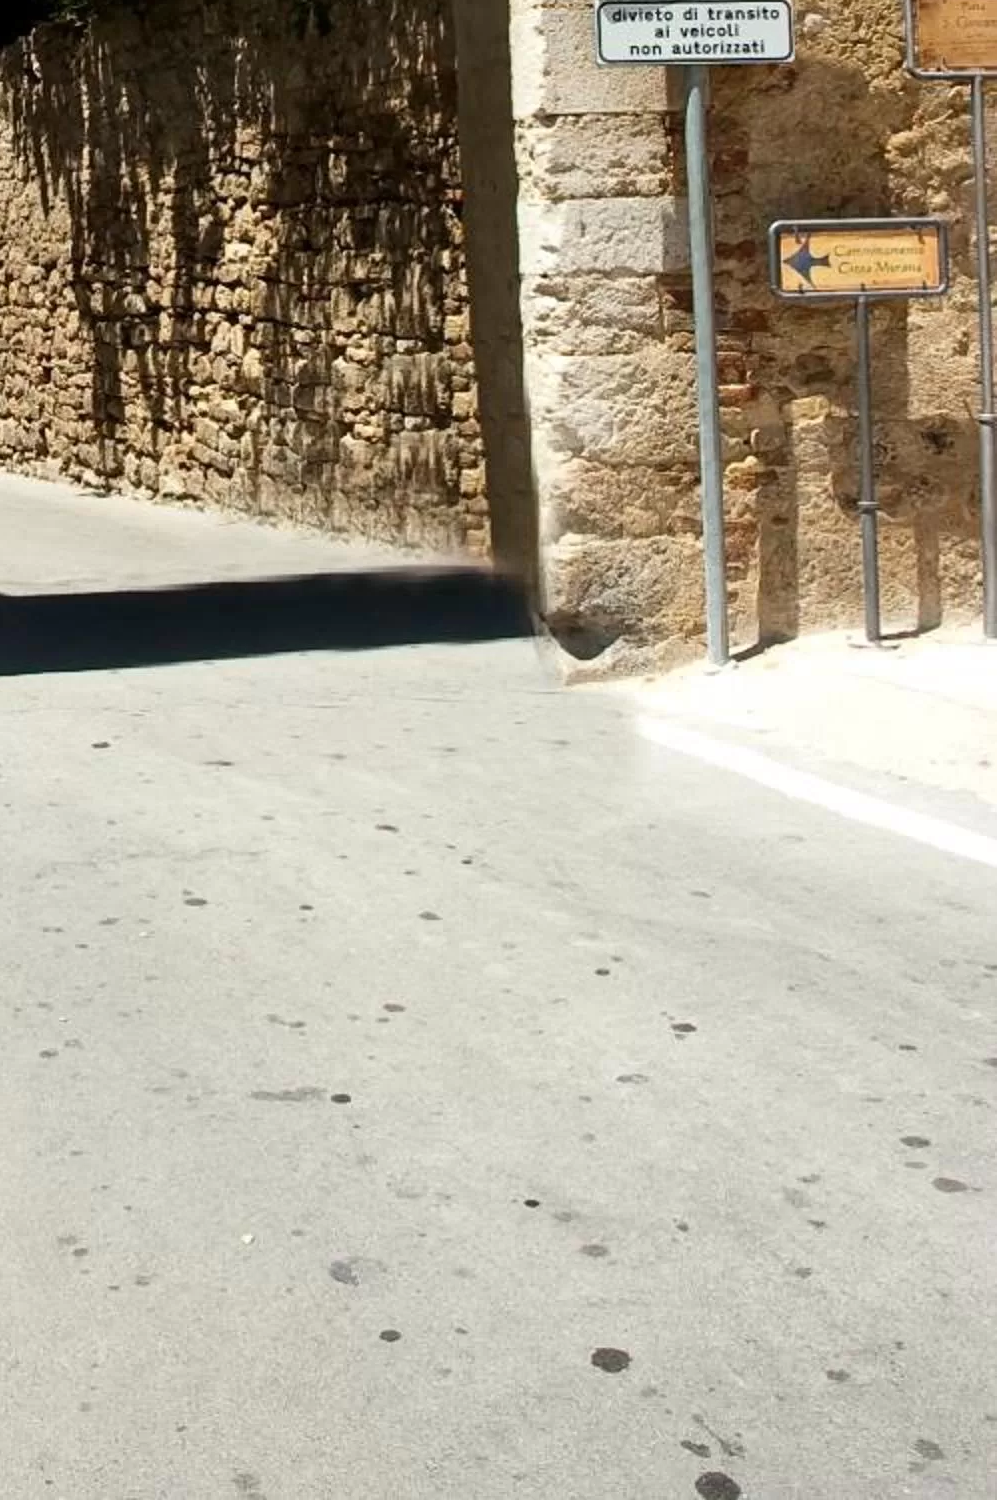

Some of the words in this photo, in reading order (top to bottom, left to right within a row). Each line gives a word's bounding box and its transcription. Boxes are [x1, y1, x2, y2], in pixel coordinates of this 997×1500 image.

[611, 6, 674, 22] divieto
[683, 6, 698, 21] di
[707, 5, 780, 21] transito
[654, 25, 670, 38] ai
[679, 23, 740, 38] veicoli
[630, 43, 662, 56] non
[671, 40, 765, 55] autorizzati
